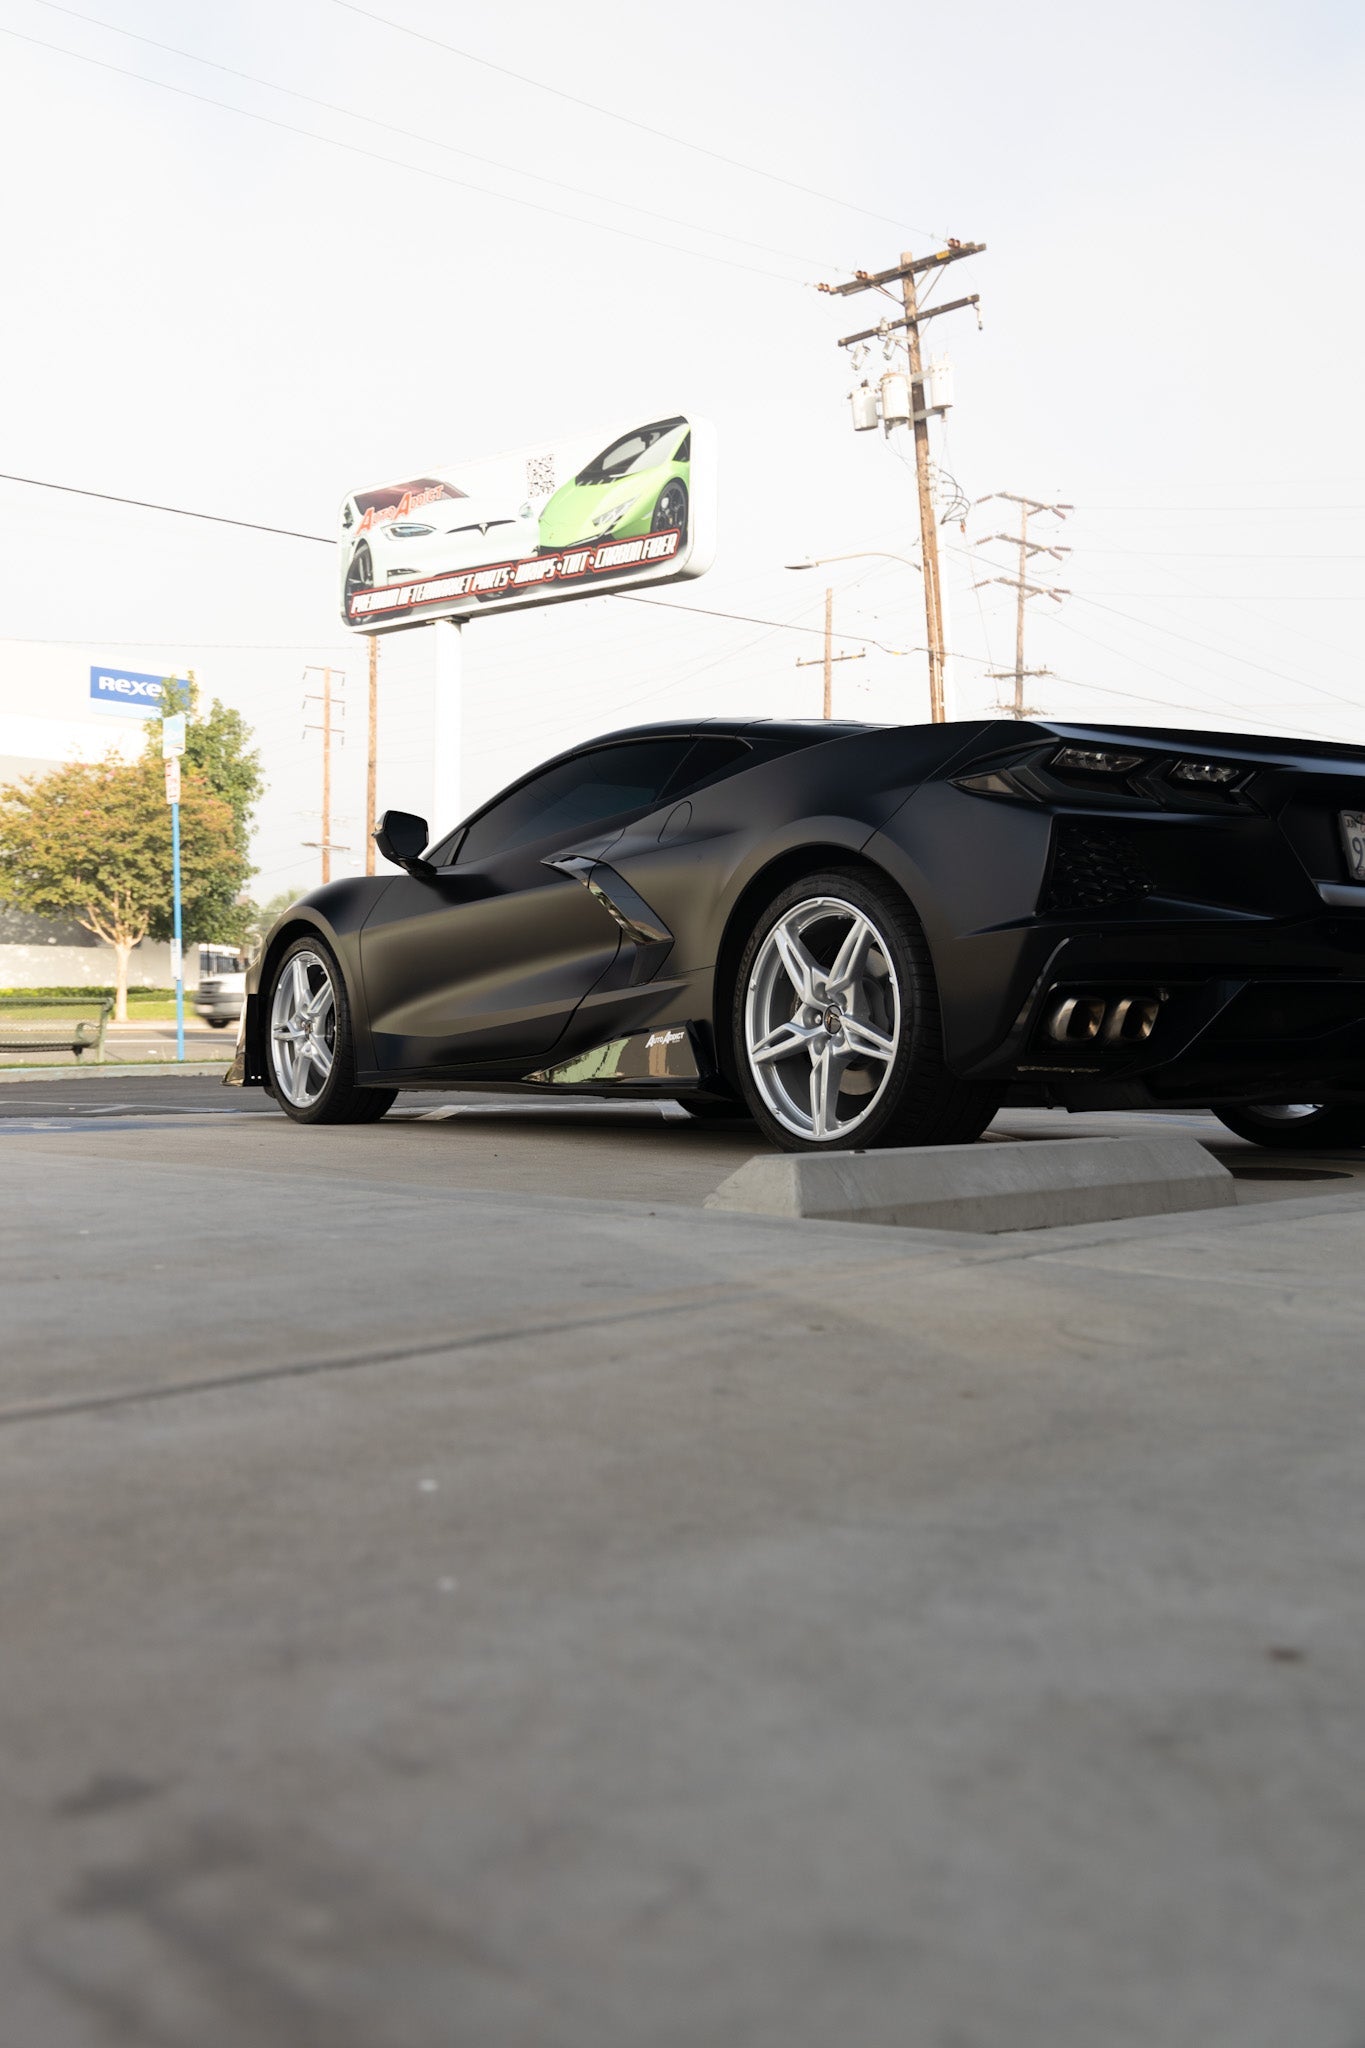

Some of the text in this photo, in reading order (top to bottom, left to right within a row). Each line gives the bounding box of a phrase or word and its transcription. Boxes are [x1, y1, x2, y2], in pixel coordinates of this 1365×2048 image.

[398, 574, 475, 605] AFTERMARKET
[471, 567, 511, 592] PARTS
[561, 552, 590, 575] TINT
[594, 540, 644, 569] CARBON
[641, 533, 678, 560] FIBER
[98, 676, 163, 697] Rexe
